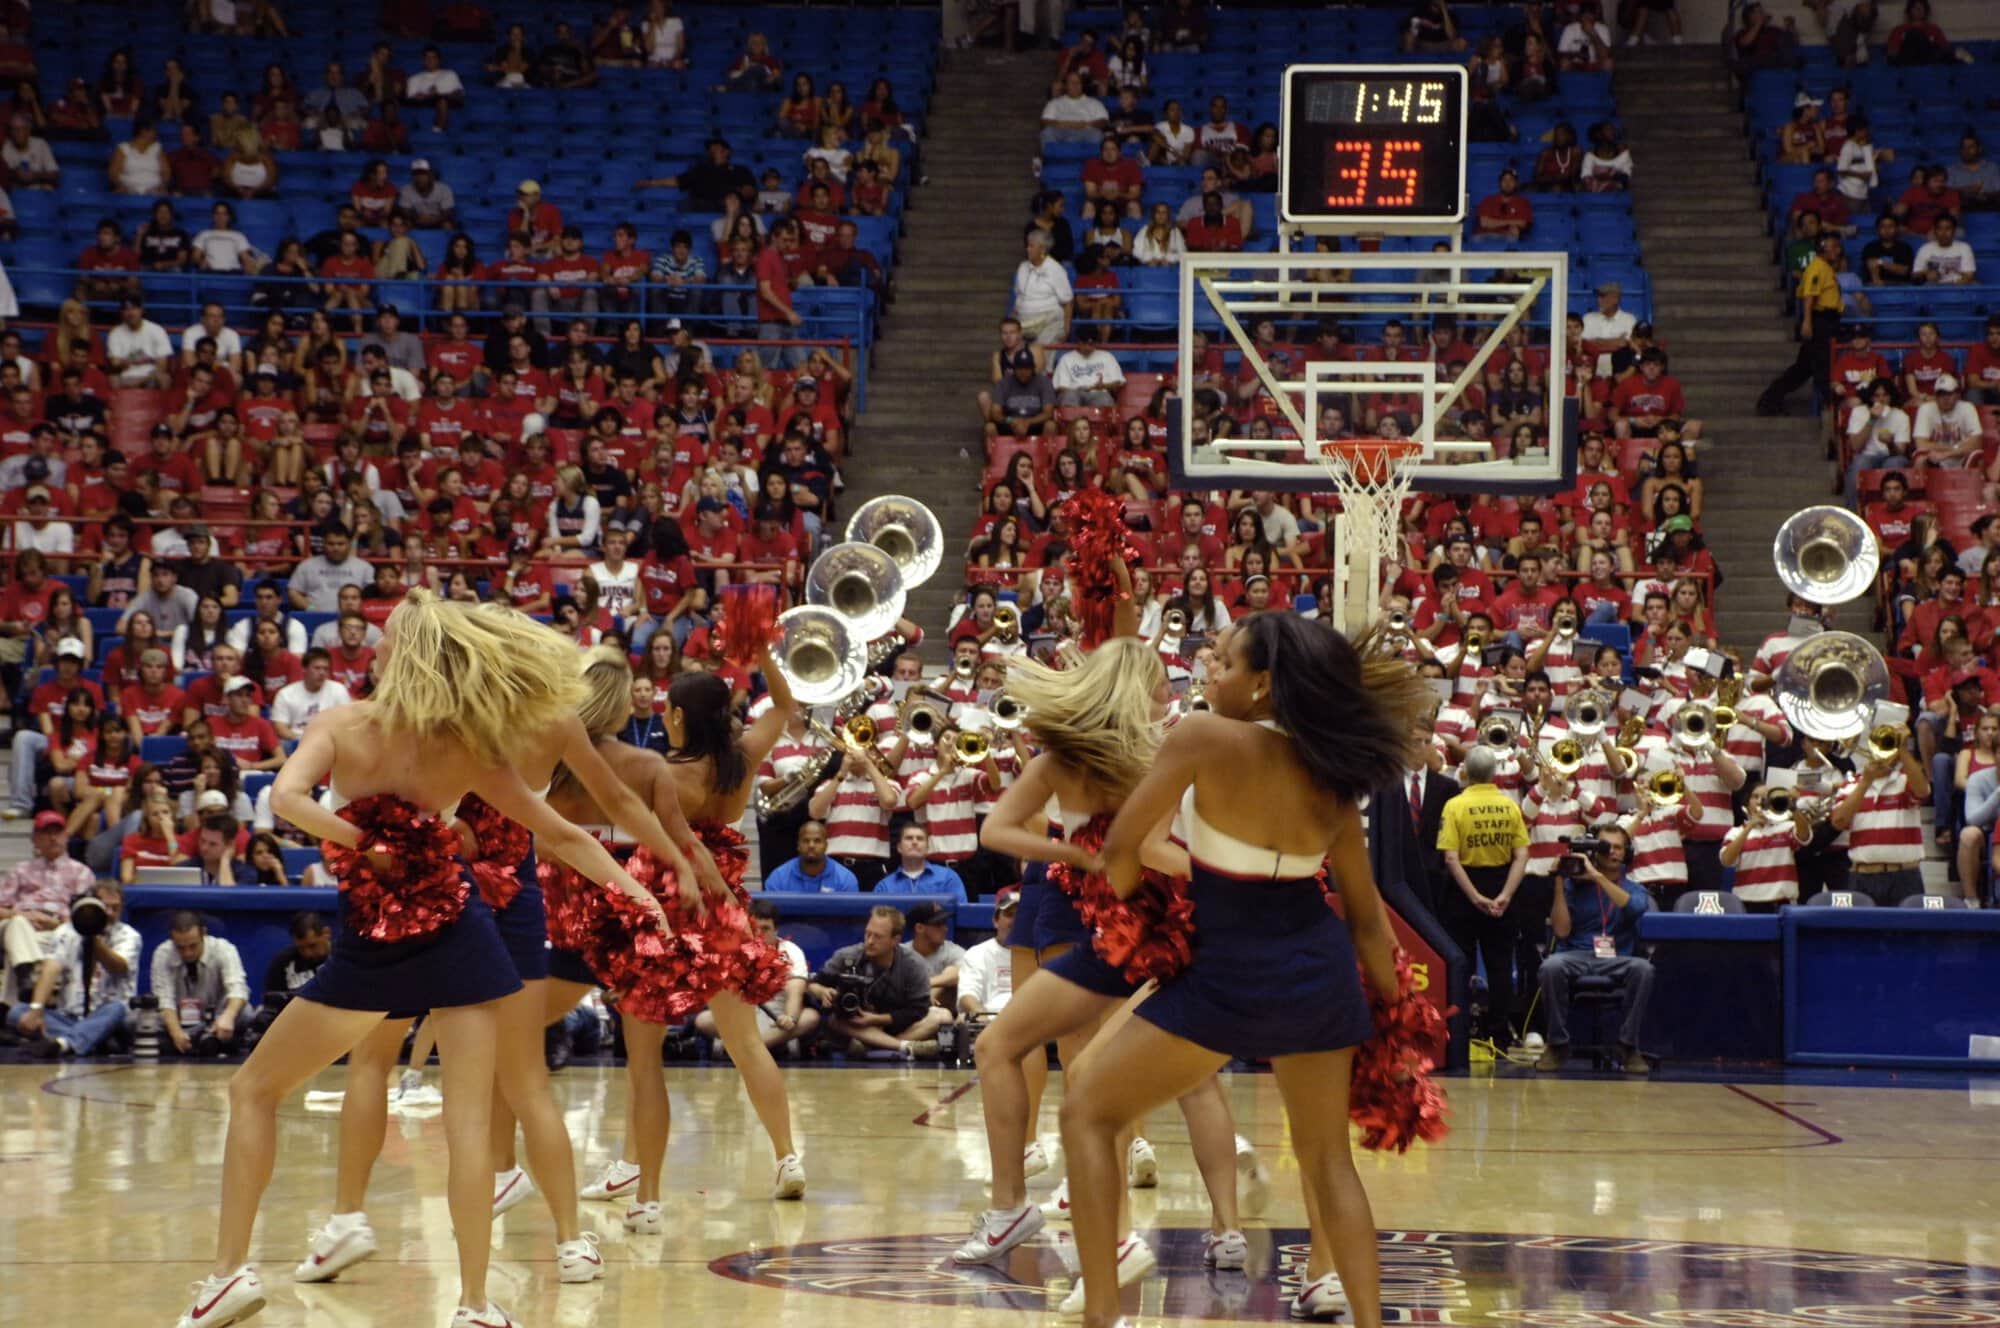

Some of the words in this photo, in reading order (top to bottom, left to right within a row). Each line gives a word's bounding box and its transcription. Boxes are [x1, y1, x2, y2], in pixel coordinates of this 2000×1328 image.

[1355, 82, 1444, 123] 1:45
[1328, 141, 1421, 206] 35
[1468, 805, 1512, 815] EVENT
[1474, 819, 1511, 829] STAFF
